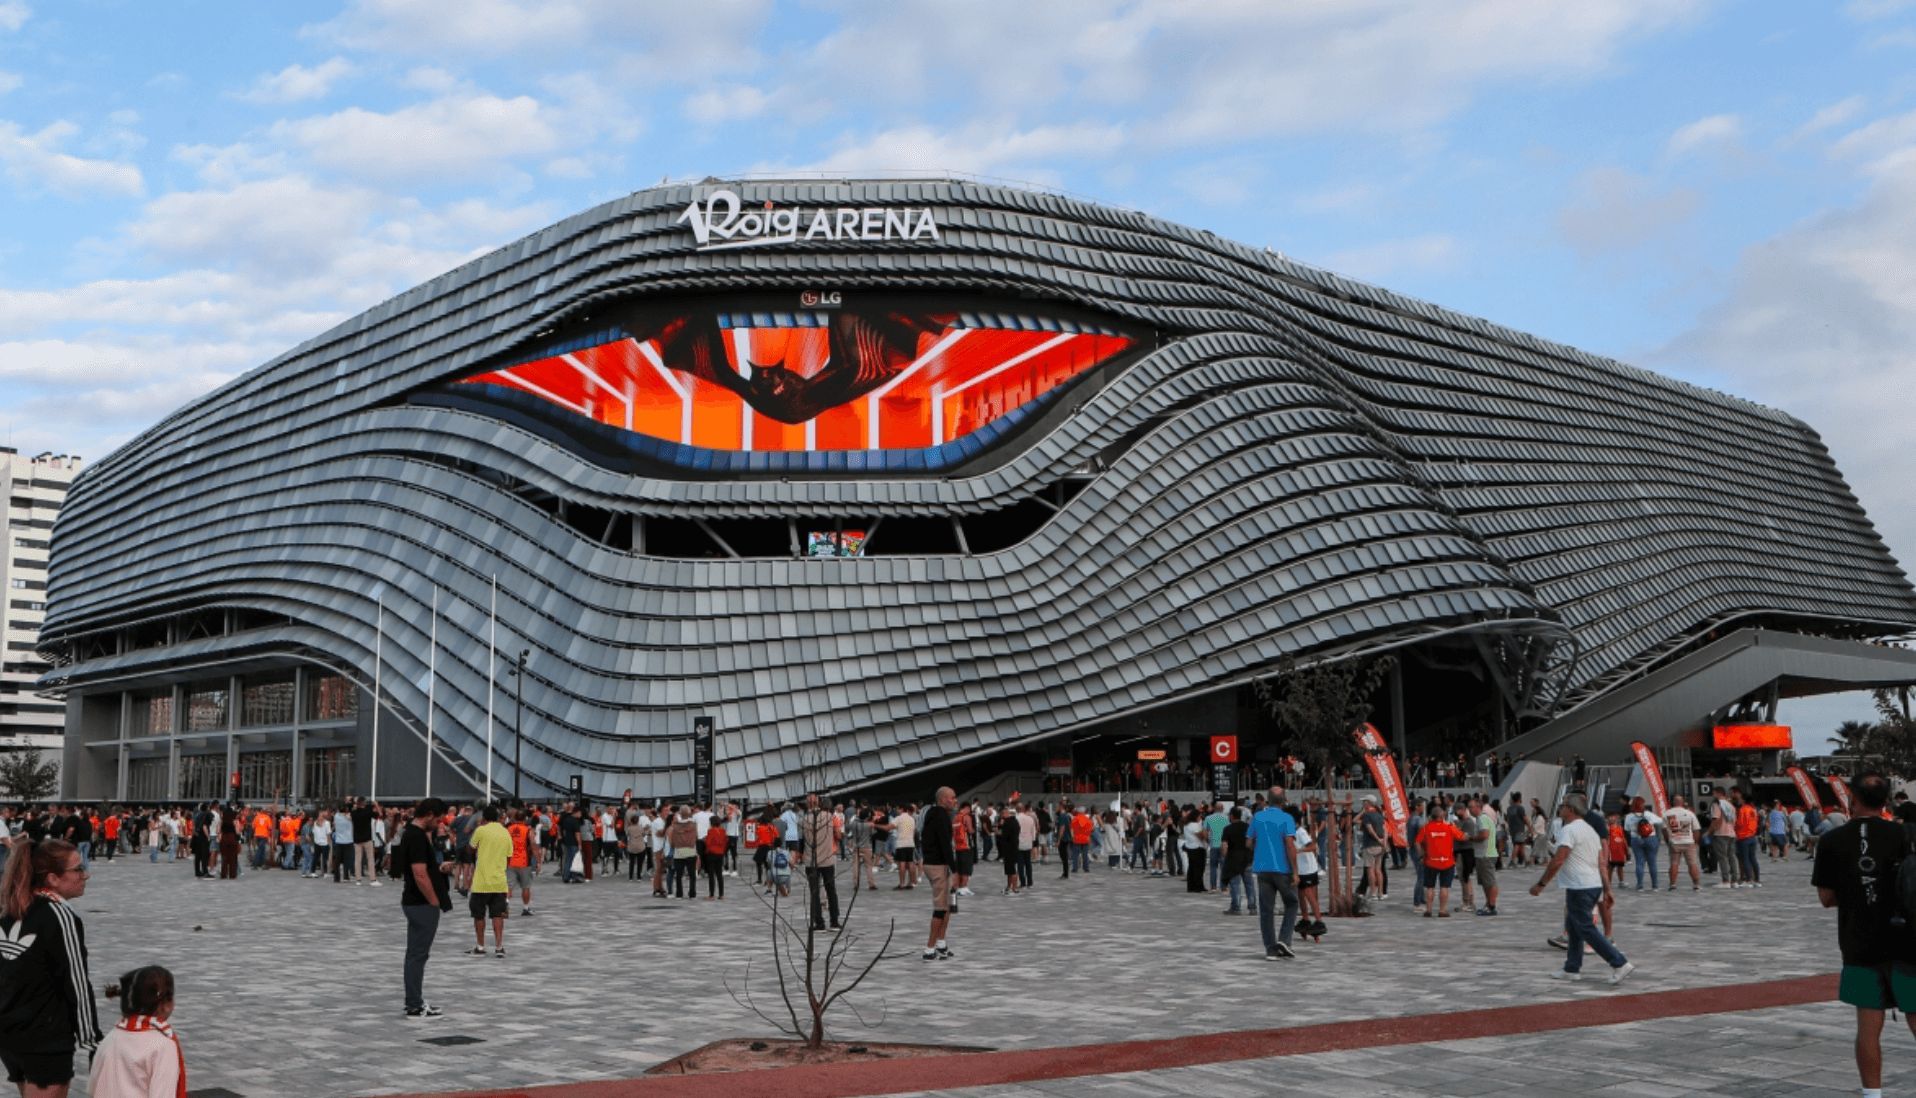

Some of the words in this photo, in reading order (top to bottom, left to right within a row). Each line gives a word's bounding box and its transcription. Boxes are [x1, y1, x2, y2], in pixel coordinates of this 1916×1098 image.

[676, 190, 799, 251] Roig
[804, 207, 940, 240] ARENA
[821, 292, 842, 304] LG
[1215, 741, 1231, 757] C
[1700, 784, 1710, 794] D
